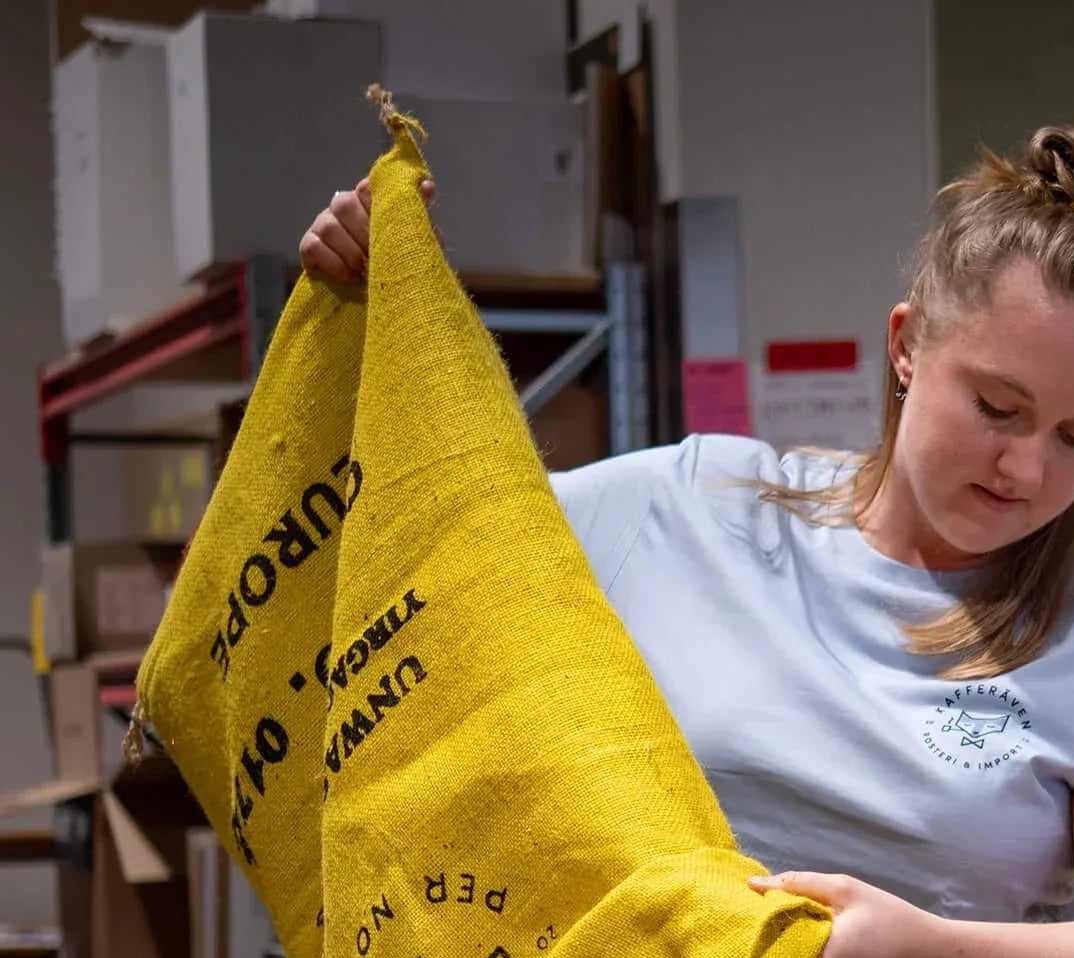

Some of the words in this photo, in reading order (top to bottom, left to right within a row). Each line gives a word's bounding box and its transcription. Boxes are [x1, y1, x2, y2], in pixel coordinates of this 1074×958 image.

[327, 588, 427, 710] YIRGA
[323, 654, 428, 801] UNWA
[978, 744, 1023, 770] IMPORT
[423, 872, 508, 914] PER
